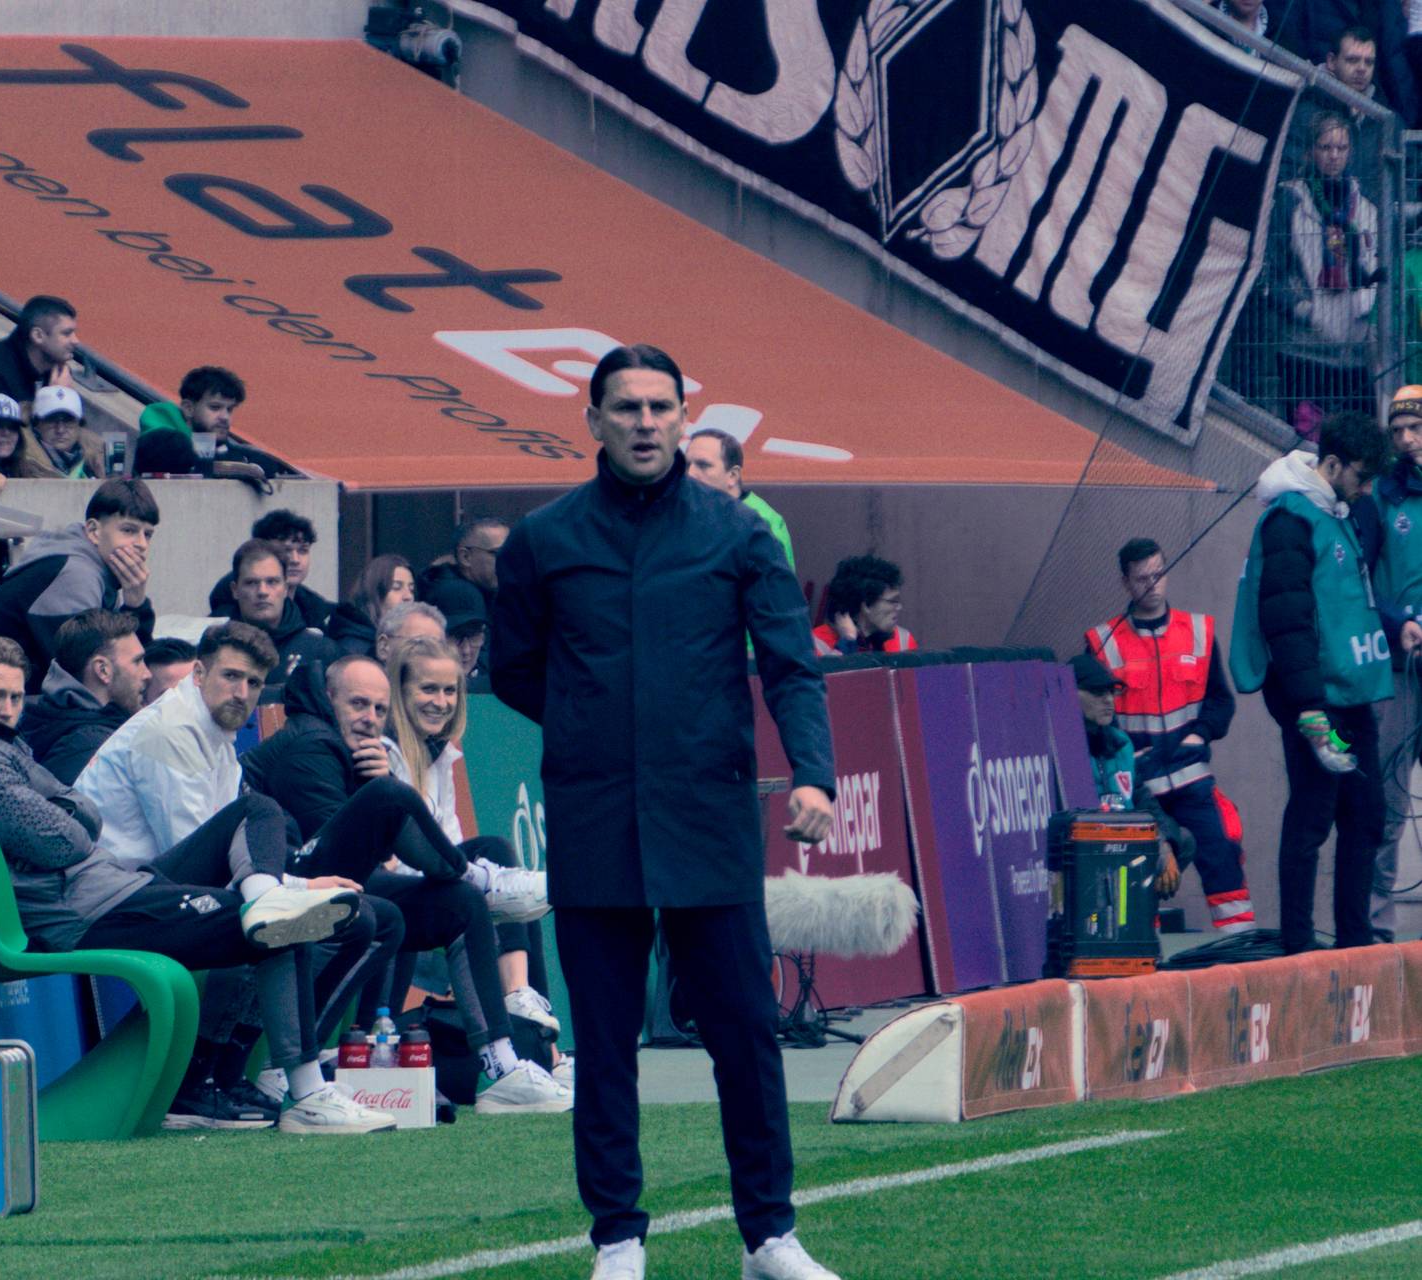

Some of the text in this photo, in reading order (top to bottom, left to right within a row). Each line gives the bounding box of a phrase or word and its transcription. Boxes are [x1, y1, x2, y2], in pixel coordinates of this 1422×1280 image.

[96, 229, 256, 276] bei
[223, 295, 378, 361] den
[364, 371, 586, 459] Profis
[986, 754, 1052, 851] sonepar
[1104, 843, 1128, 853] PELI
